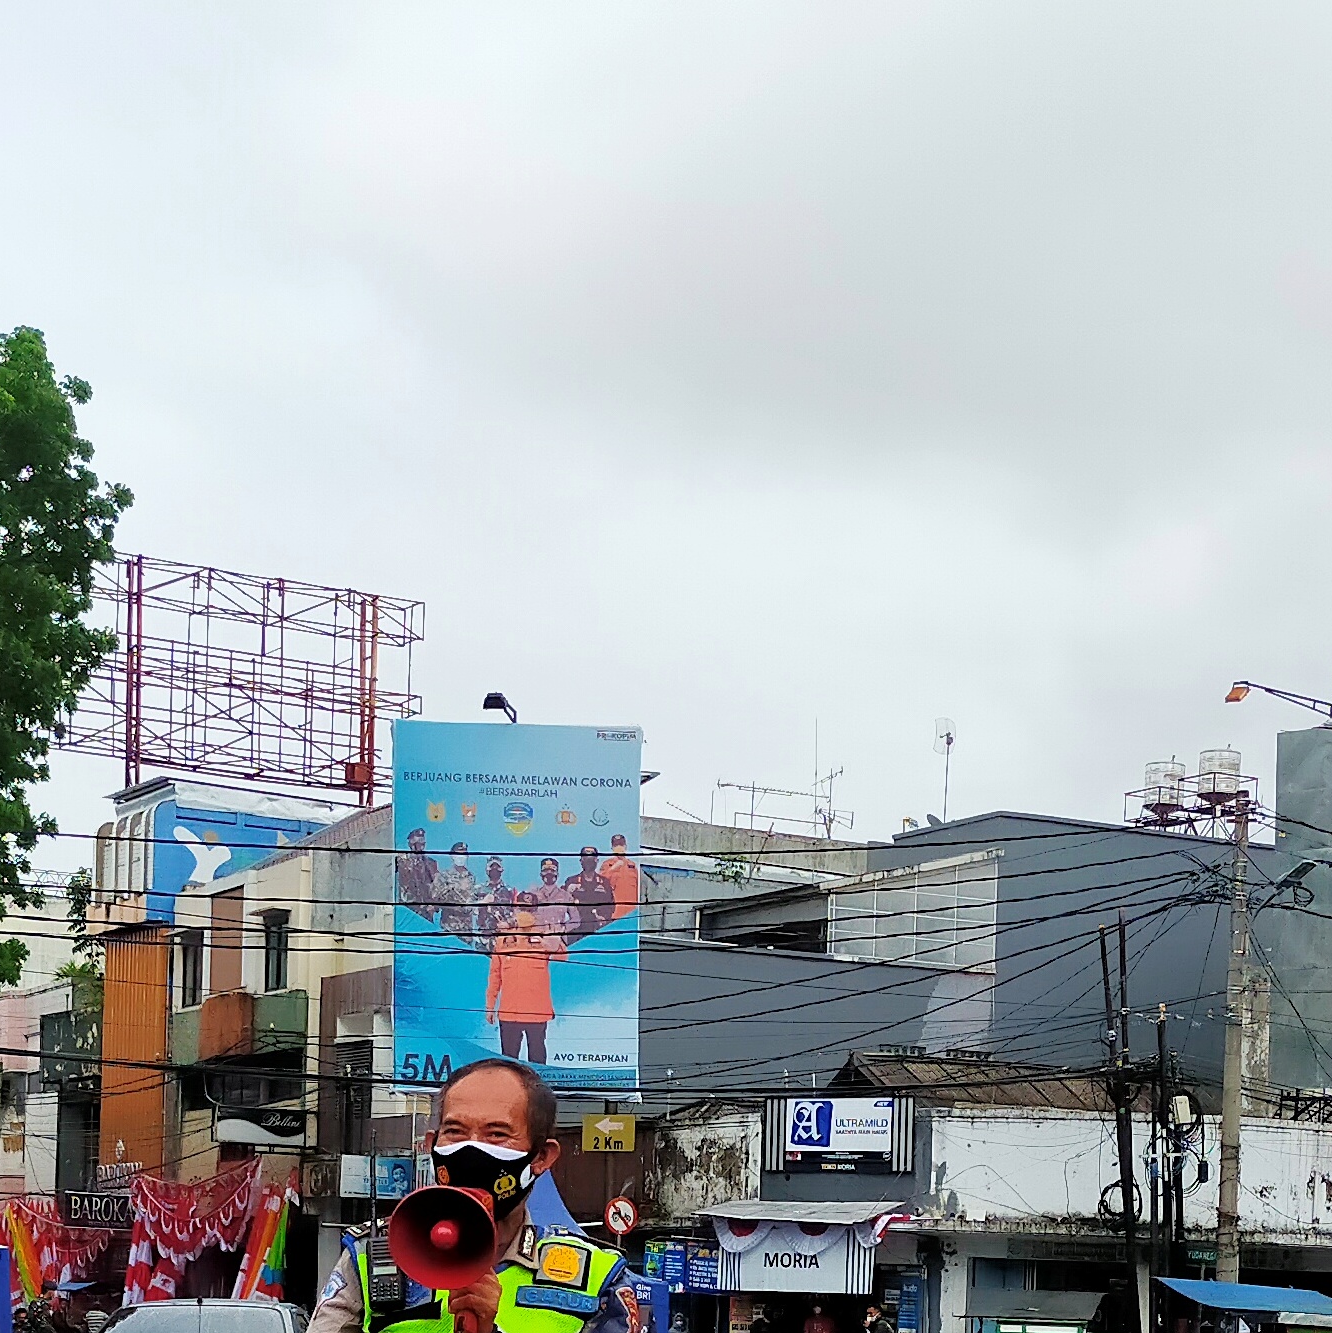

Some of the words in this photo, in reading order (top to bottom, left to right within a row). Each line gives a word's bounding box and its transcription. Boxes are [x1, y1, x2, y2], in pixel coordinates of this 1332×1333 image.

[403, 771, 462, 783] BERJUANG
[465, 773, 518, 785] BERSAMA
[521, 775, 578, 787] MELAWAN
[581, 777, 632, 788] CORONA
[479, 787, 558, 798] #BERSABARLAH
[554, 1053, 574, 1062] AYO
[577, 1053, 629, 1063] TERAPKAN
[400, 1054, 455, 1082] 5M
[835, 1118, 888, 1128] ULTRAMILD
[593, 1137, 599, 1150] 2
[604, 1137, 624, 1150] Km
[764, 1252, 820, 1269] MORIA
